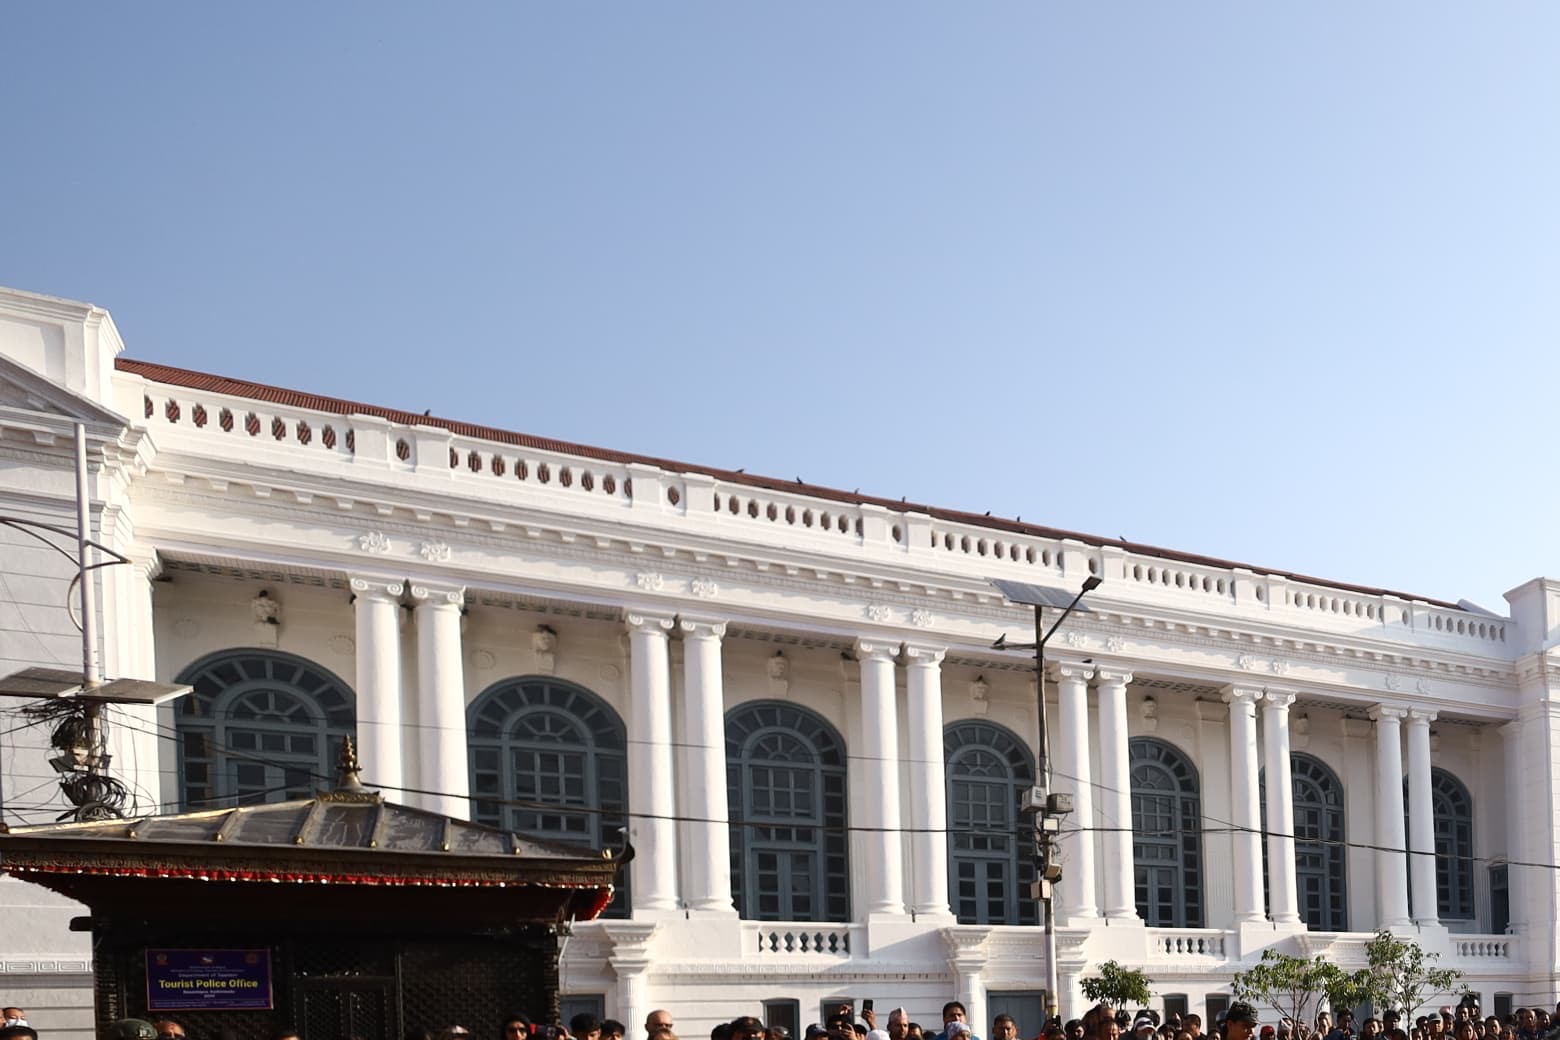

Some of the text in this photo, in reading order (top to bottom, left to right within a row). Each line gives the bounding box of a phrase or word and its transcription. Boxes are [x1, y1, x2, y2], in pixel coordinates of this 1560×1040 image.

[158, 978, 259, 989] Tourist Police Office
